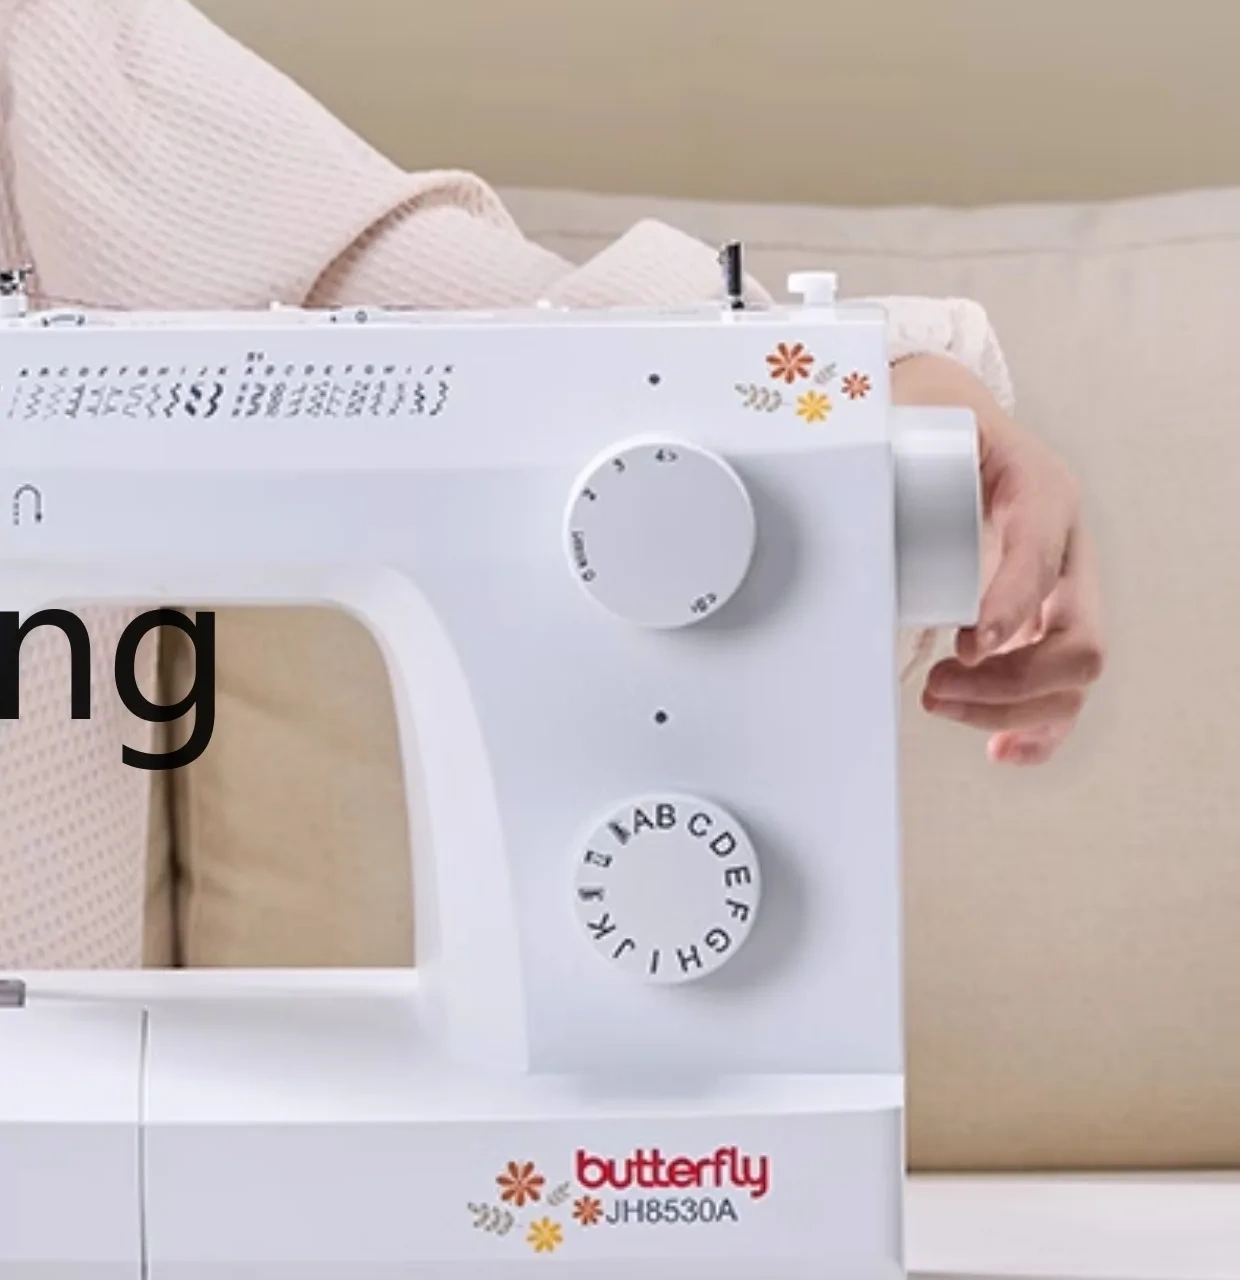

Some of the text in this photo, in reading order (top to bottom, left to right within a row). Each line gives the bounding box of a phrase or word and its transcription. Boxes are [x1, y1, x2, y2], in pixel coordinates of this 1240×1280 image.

[687, 812, 713, 838] C
[709, 831, 737, 858] D
[724, 865, 751, 888] E
[725, 898, 750, 922] F
[587, 912, 616, 941] K
[704, 927, 732, 954] G
[676, 944, 703, 973] H
[575, 1146, 768, 1199] butterfly
[605, 1196, 739, 1225] JH8530A
